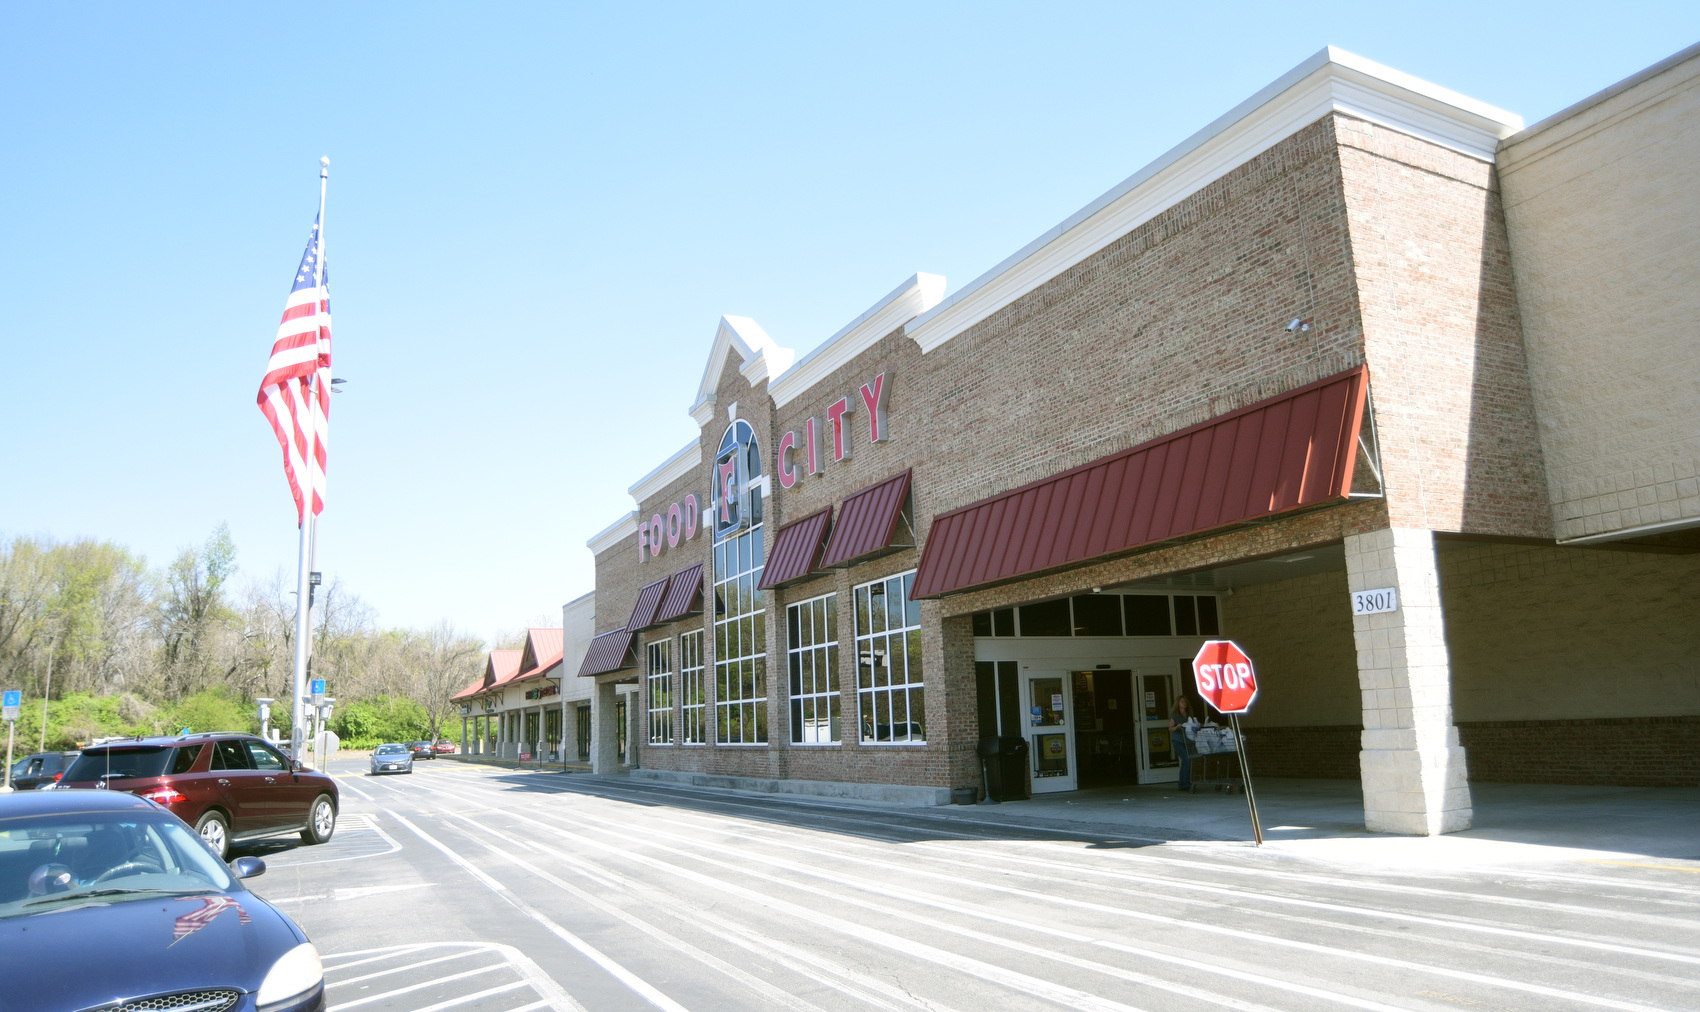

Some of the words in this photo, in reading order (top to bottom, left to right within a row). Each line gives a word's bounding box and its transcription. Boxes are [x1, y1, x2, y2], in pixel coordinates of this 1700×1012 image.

[639, 493, 702, 563] FOOD
[779, 372, 893, 488] CITY
[1356, 592, 1392, 612] 3801
[1199, 663, 1250, 691] STOP
